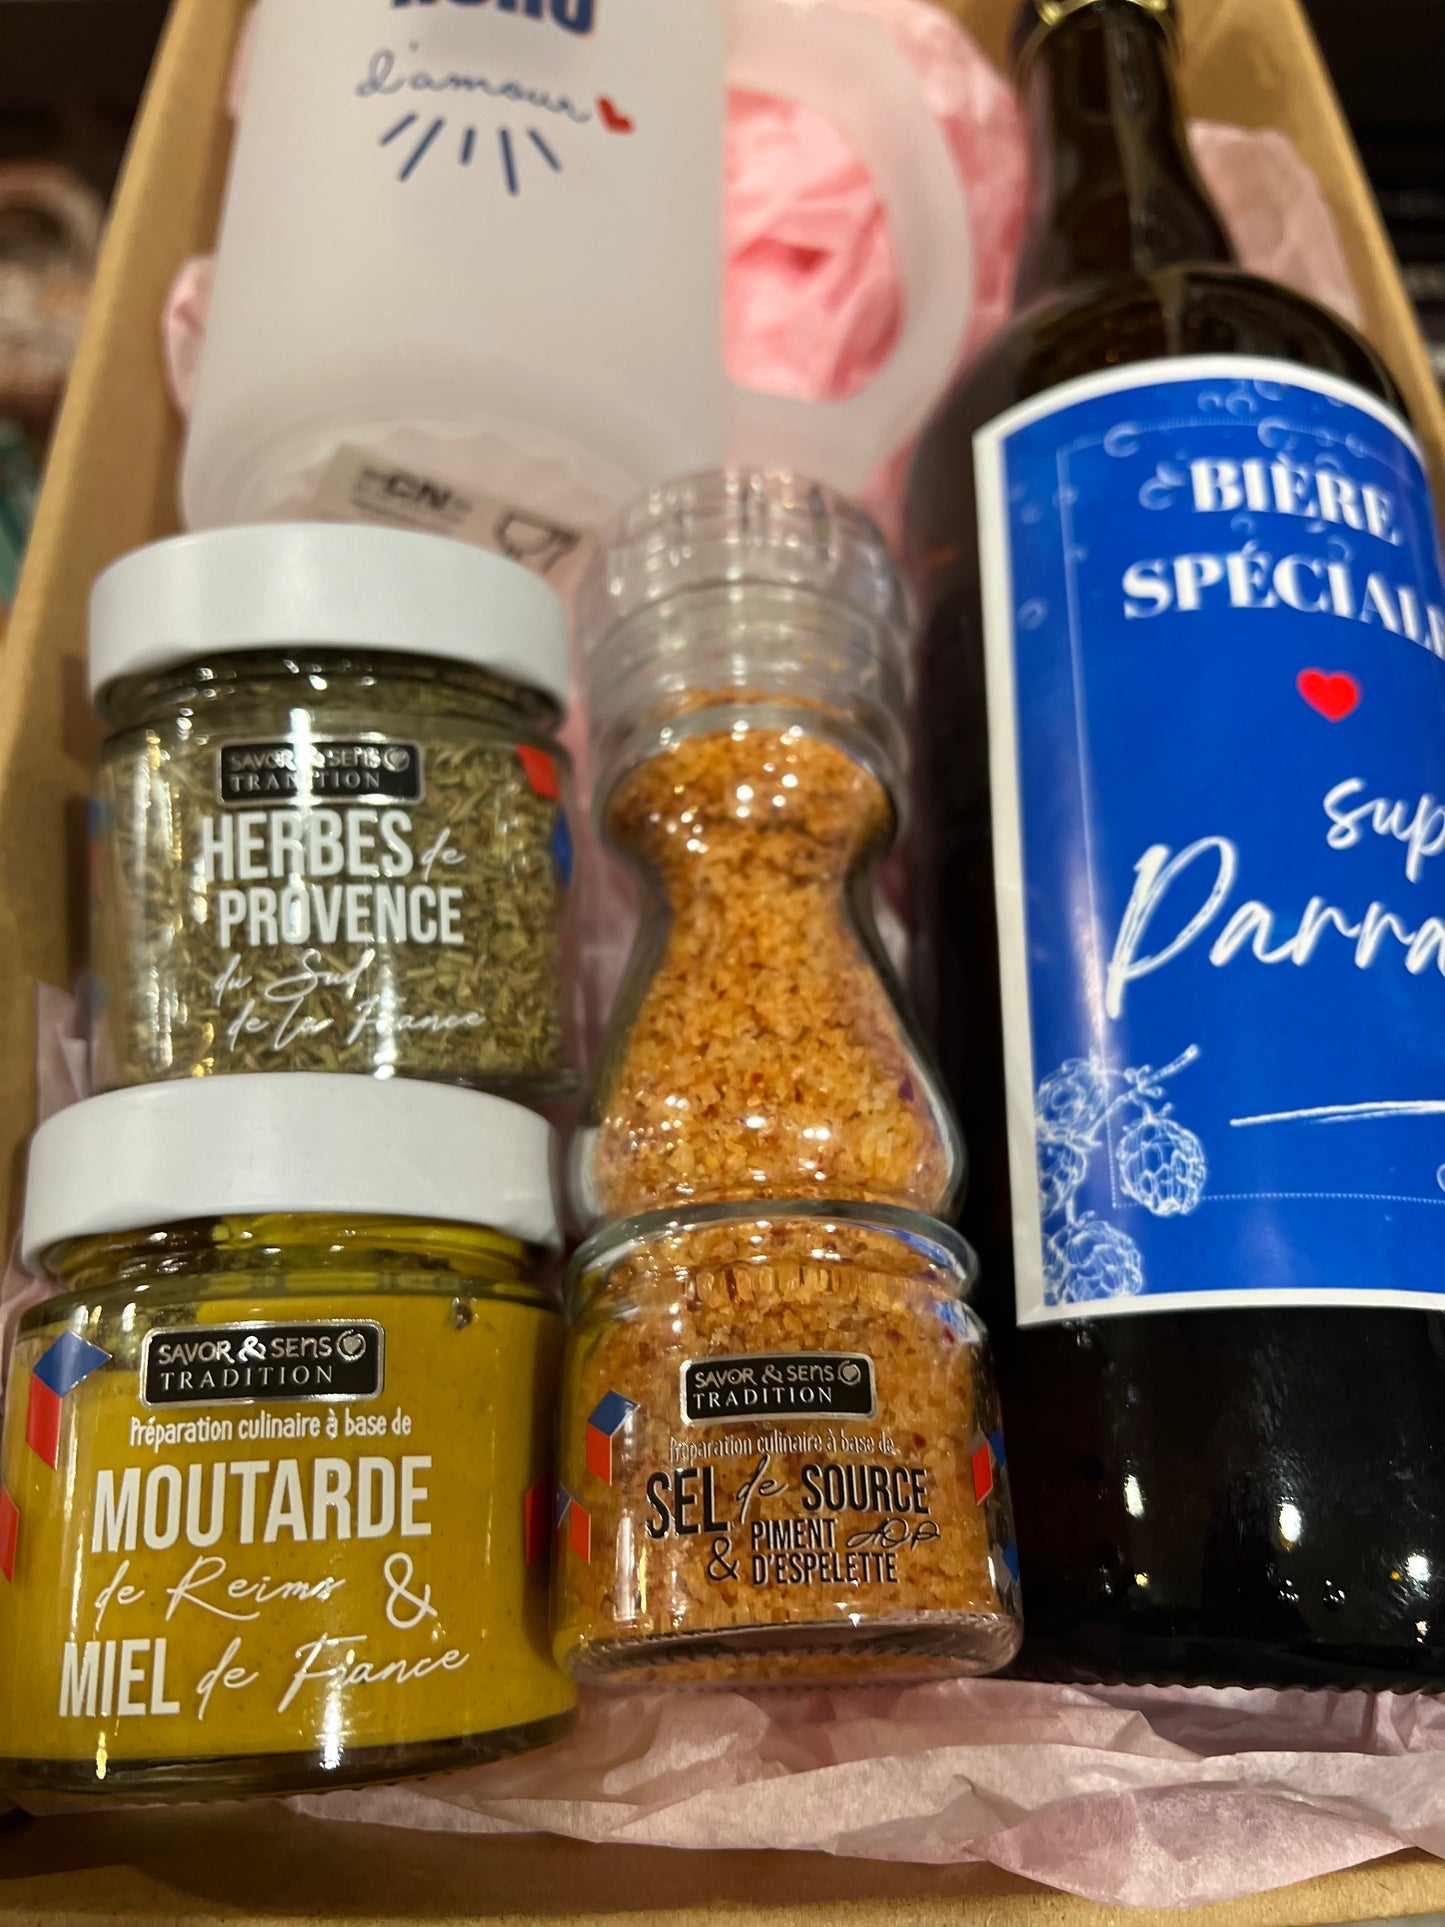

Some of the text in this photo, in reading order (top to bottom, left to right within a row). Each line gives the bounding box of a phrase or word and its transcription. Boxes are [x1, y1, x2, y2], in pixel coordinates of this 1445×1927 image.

[1190, 451, 1401, 547] BIÈRE
[228, 748, 297, 771] SAVOR
[229, 769, 381, 794] TRATION
[202, 808, 466, 882] HERBES de
[217, 884, 465, 949] PROVENCE
[214, 947, 376, 1006] du Sud
[227, 998, 270, 1052] de
[158, 1340, 236, 1367] SAVOR
[238, 1335, 268, 1363] &
[694, 1367, 757, 1390] SAVOR
[761, 1363, 785, 1385] &
[160, 1366, 334, 1391] TRADITION
[692, 1385, 833, 1410] TRADITION
[129, 1405, 412, 1454] Préparation culinaire à base de
[756, 1429, 823, 1455] culinaire
[840, 1428, 875, 1455] base
[91, 1455, 432, 1554] MOUTARDE
[646, 1454, 931, 1540] SEL de SOURCE
[706, 1536, 741, 1582] &
[750, 1517, 839, 1552] PIMENT
[751, 1551, 900, 1587] D'ESPELETTE
[94, 1552, 438, 1632] de Reims &
[59, 1637, 181, 1718] MIEL
[196, 1636, 260, 1721] de
